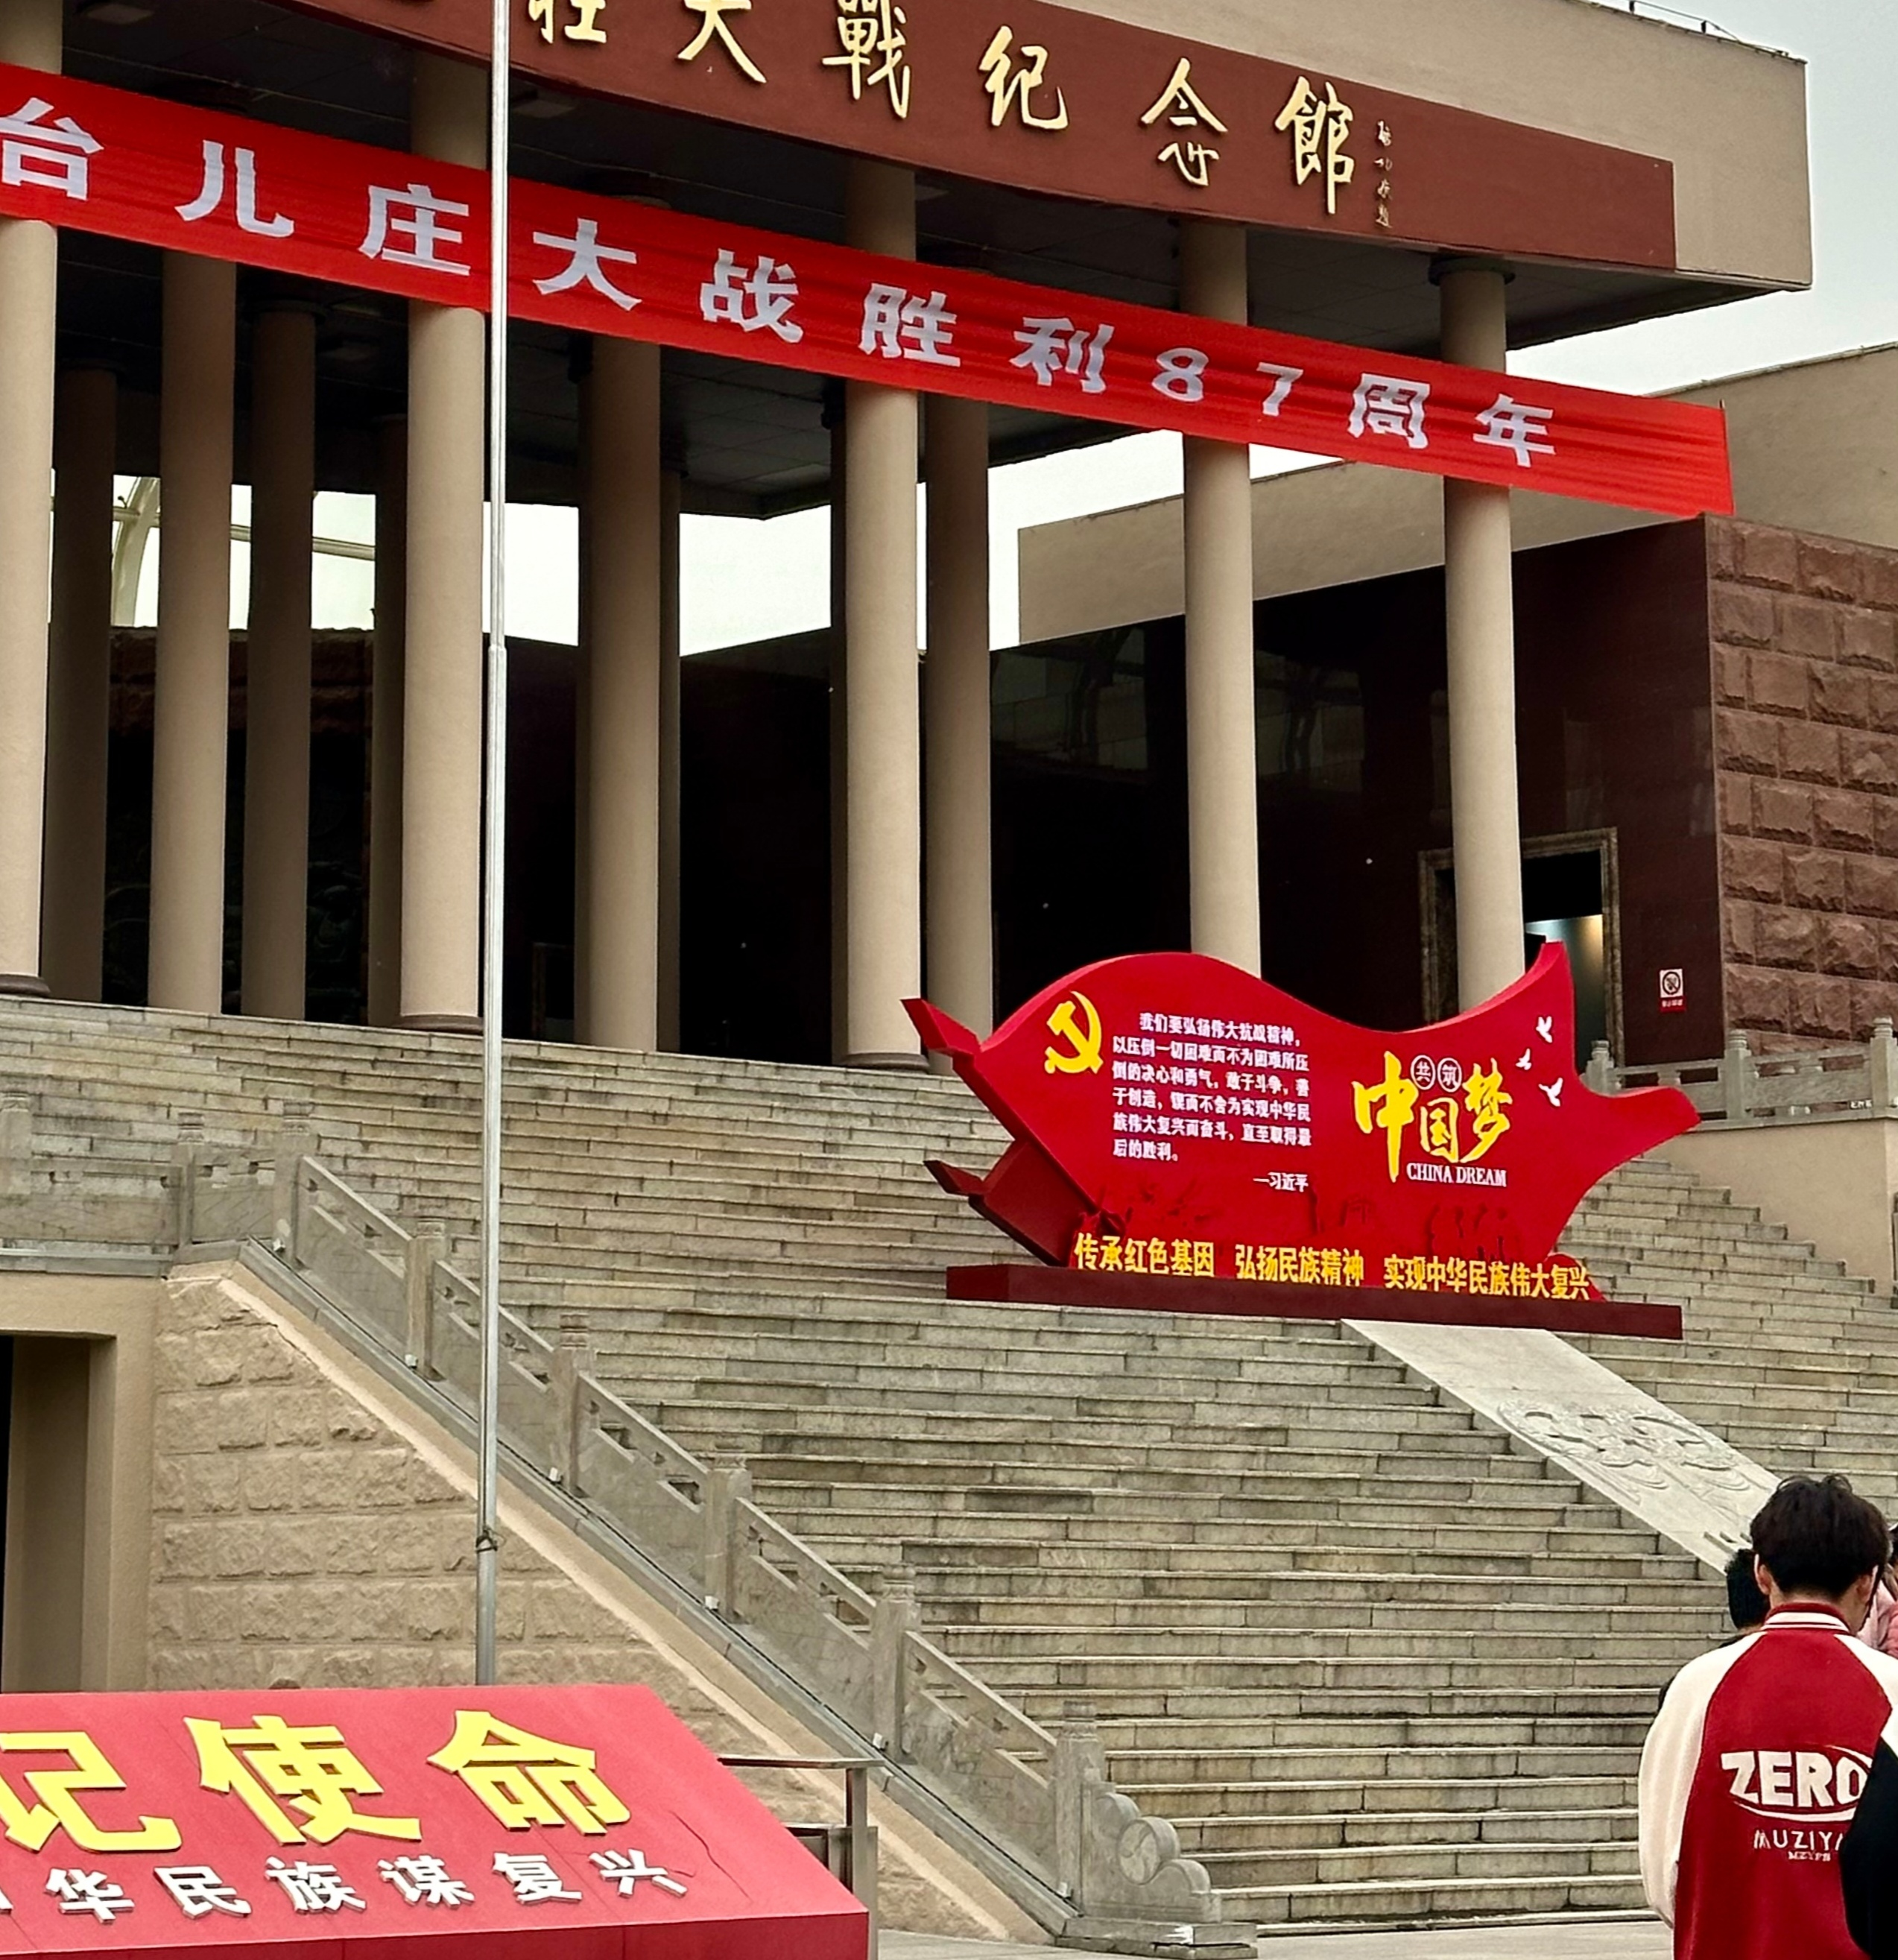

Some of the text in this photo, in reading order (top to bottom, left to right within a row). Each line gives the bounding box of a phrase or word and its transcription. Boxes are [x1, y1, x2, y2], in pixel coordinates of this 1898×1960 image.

[0, 97, 1556, 468] 台儿庄大战胜利87周年
[1113, 1035, 1310, 1072] 以压倒一切困难而不为困难所压
[1414, 1060, 1459, 1088] 共筑
[1351, 1050, 1513, 1184] 中国梦
[1113, 1138, 1179, 1162] 后的胜利。
[1406, 1163, 1507, 1187] CHINA DREAM
[1074, 1232, 1590, 1300] 传承红色基因 弘扬民族精神 实现中华民族伟大复兴
[0, 1710, 630, 1854] 记使命
[1720, 1750, 1869, 1808] ZERO
[0, 1848, 688, 1925] 华民族谋复兴
